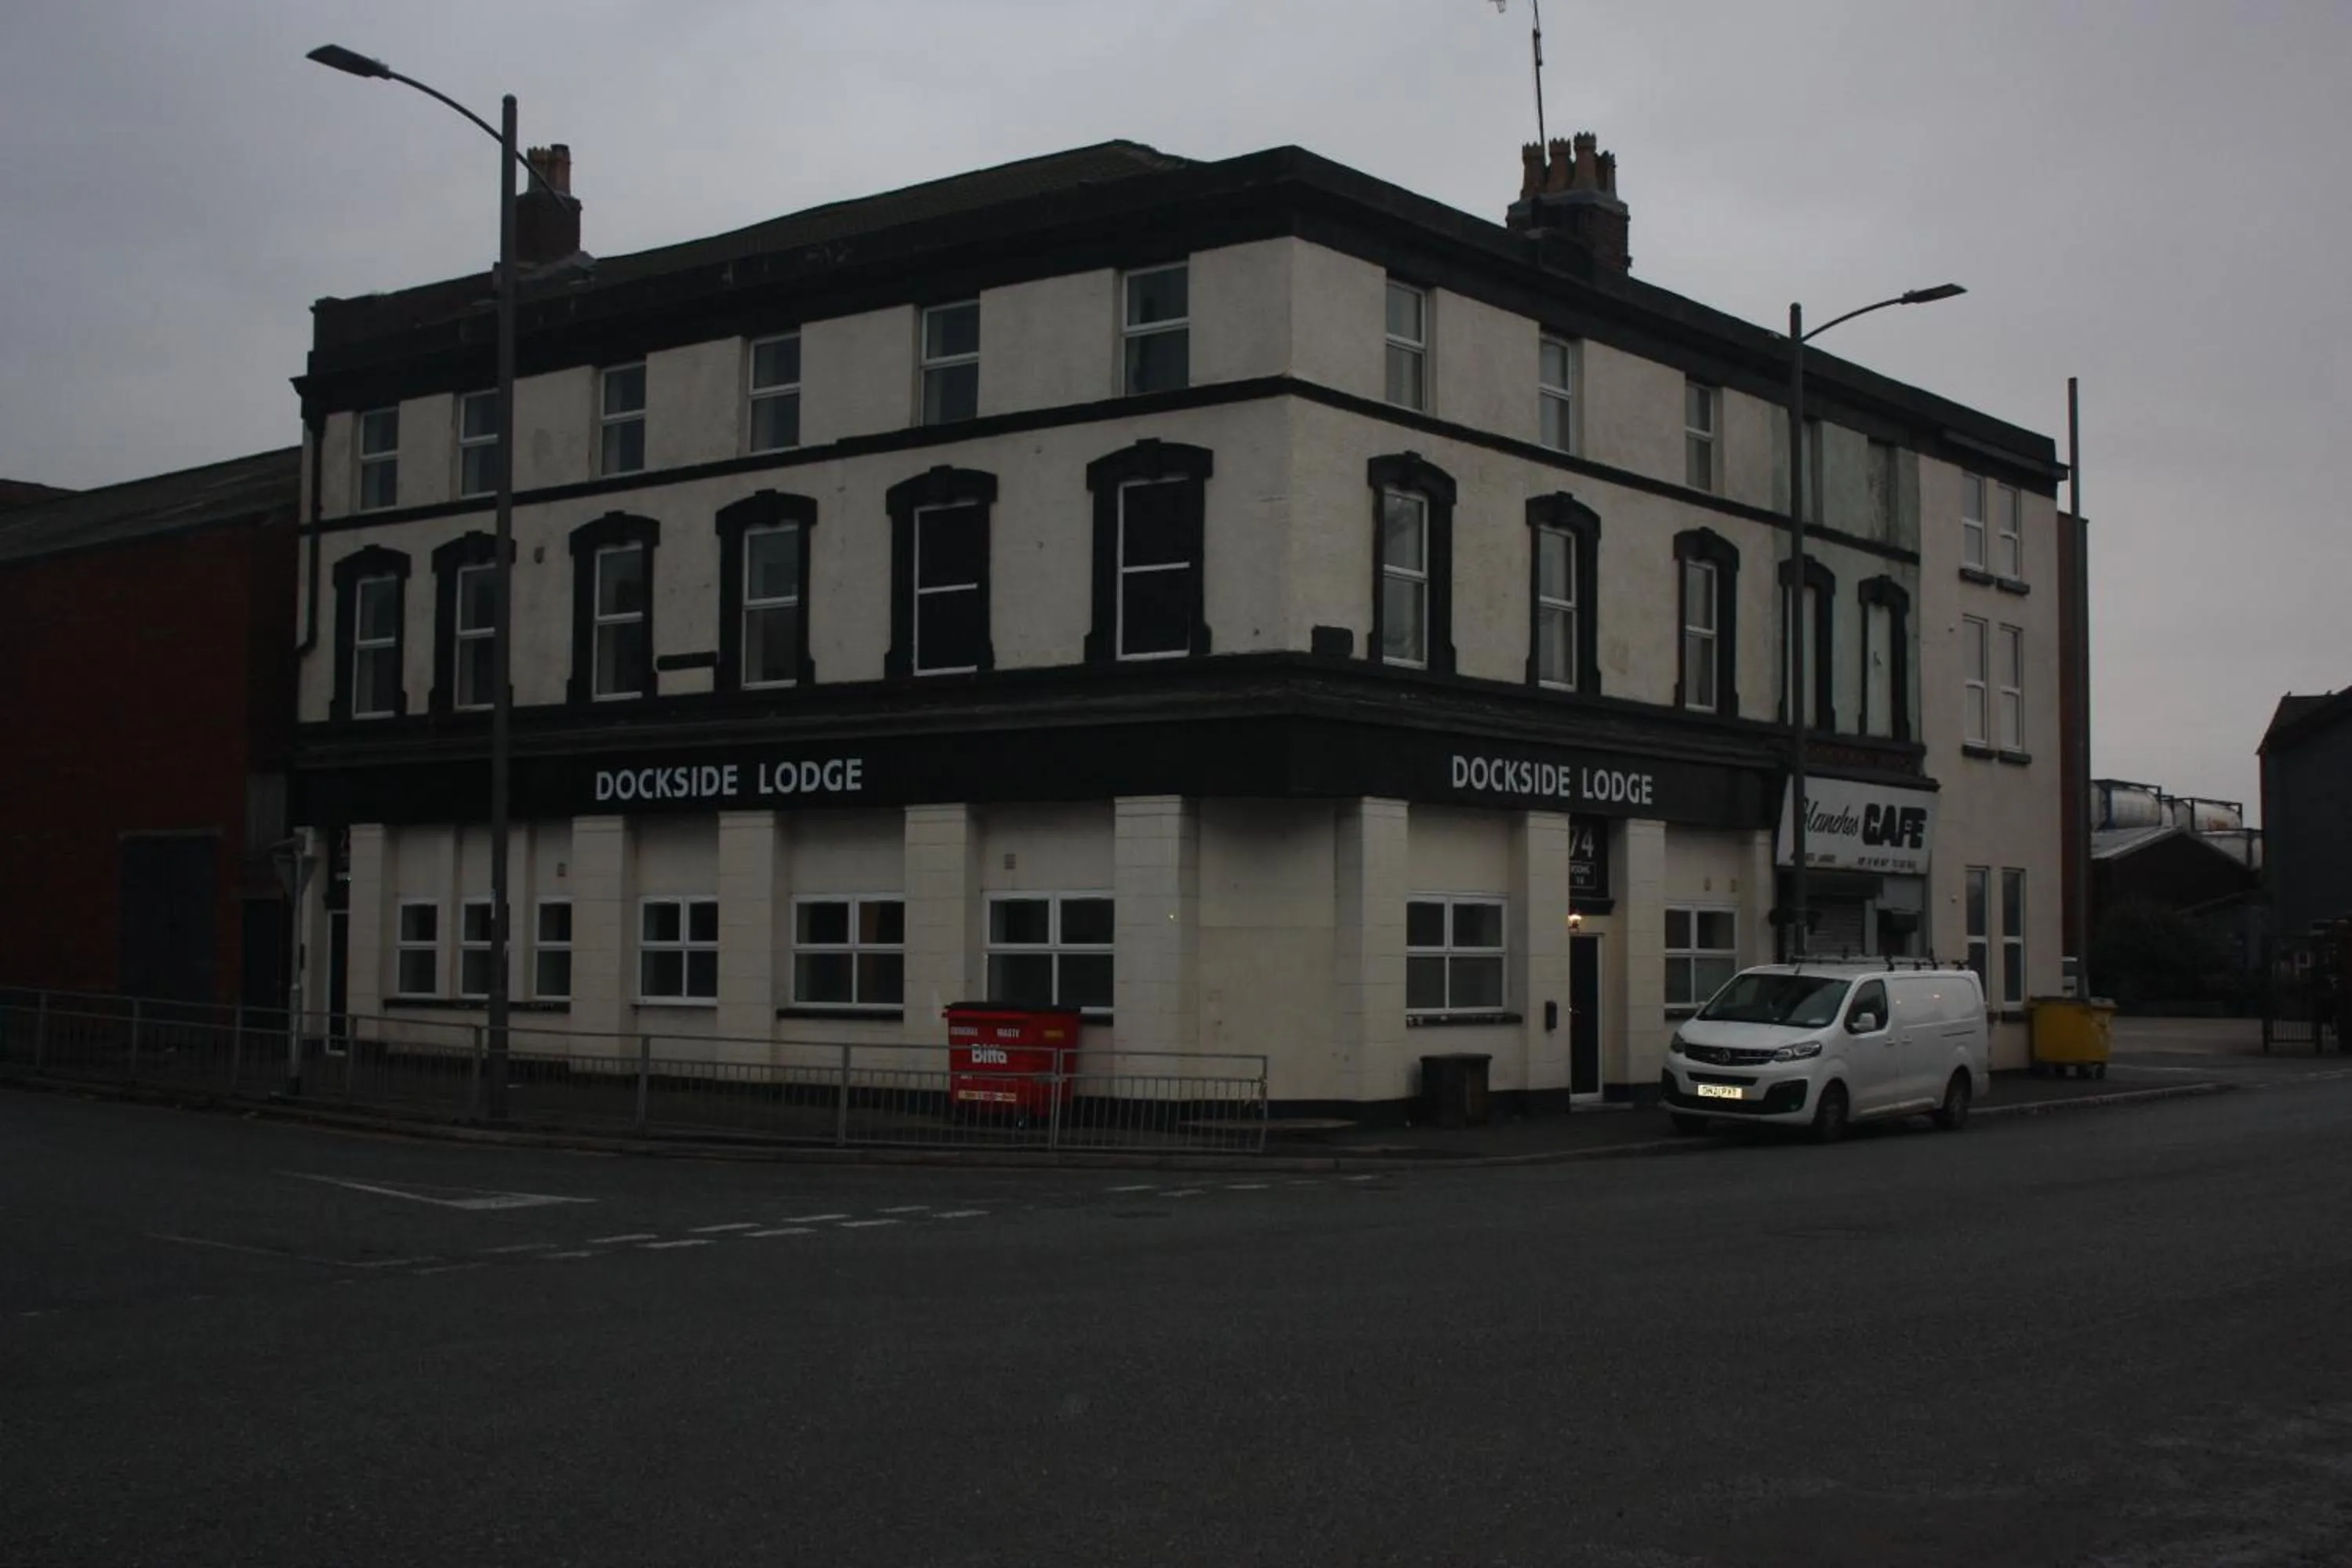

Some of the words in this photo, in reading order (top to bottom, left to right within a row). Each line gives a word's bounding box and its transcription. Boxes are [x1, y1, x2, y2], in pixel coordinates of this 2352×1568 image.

[595, 764, 739, 801] DOCKSIDE
[758, 758, 863, 794] LODGE
[1452, 754, 1571, 797] DOCKSIDE
[1581, 767, 1653, 805] LODGE
[1862, 802, 1927, 849] CAFE
[971, 1043, 1008, 1065] Biffa
